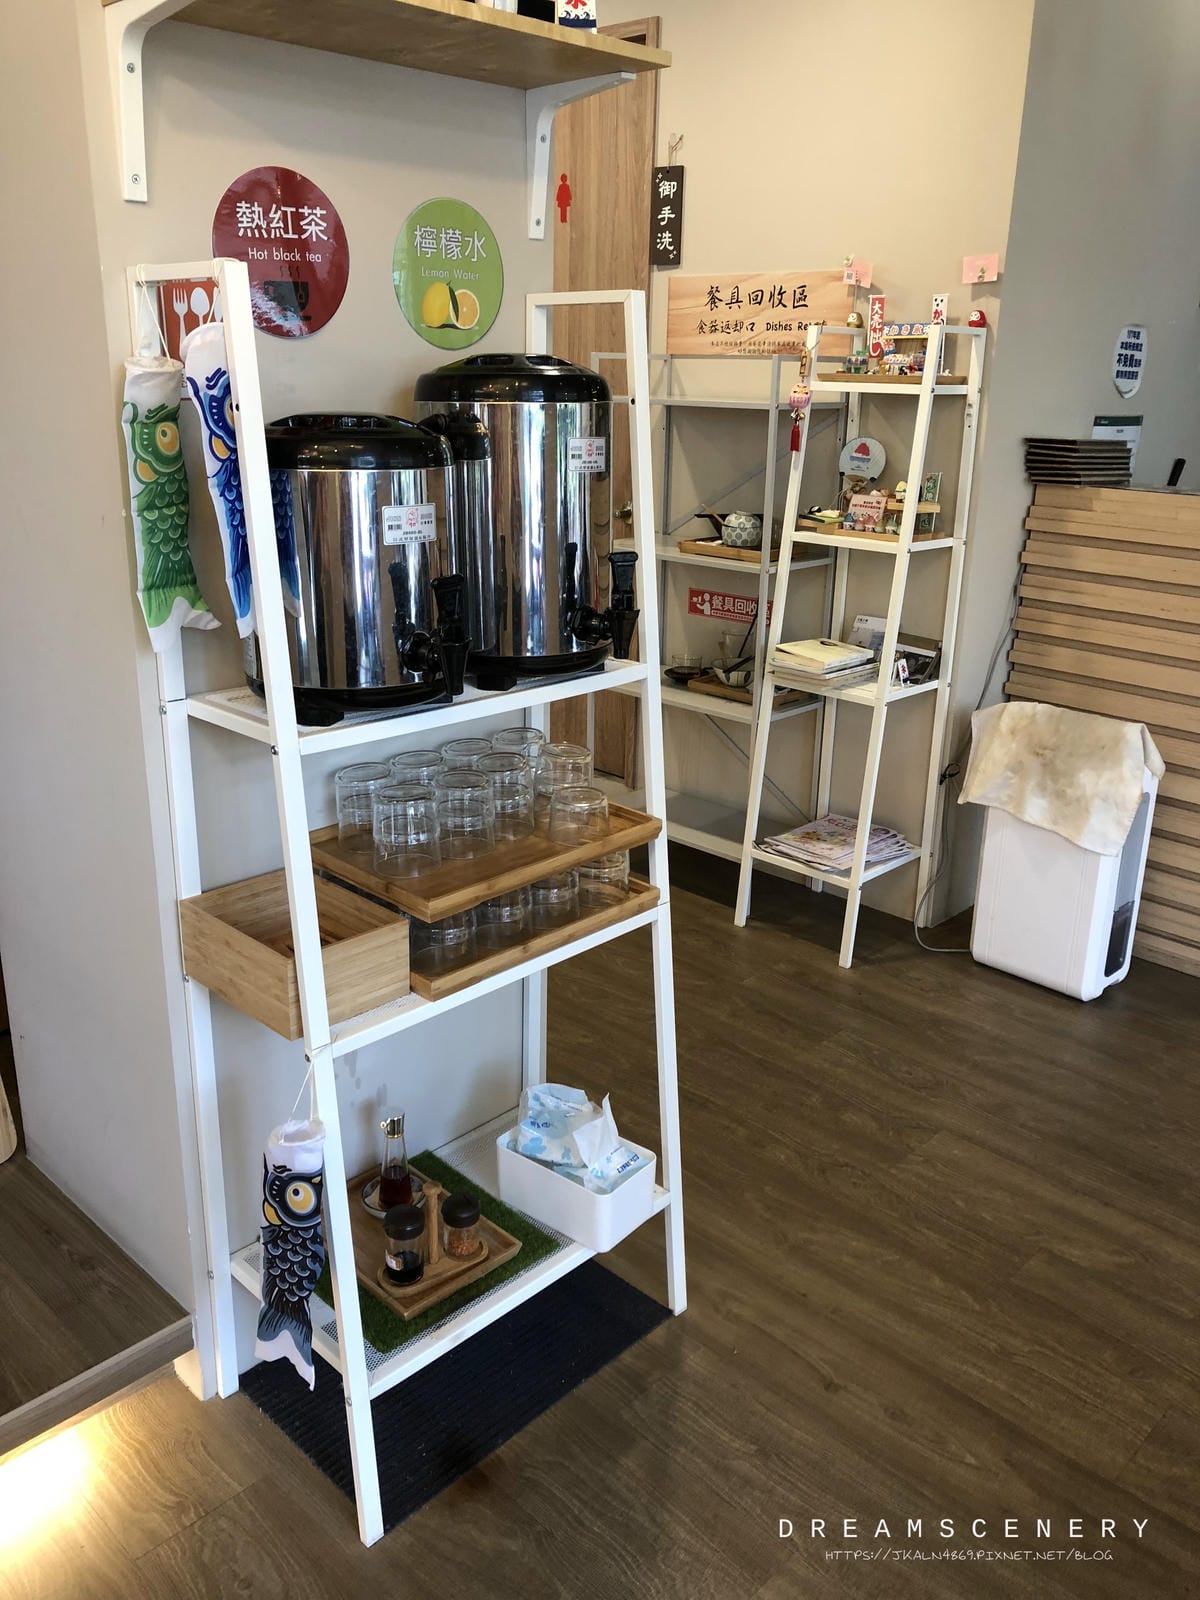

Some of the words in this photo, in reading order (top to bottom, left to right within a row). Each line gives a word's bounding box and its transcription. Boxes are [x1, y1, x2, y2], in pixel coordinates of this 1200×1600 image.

[236, 200, 328, 242] 熱紅茶
[656, 180, 678, 251] 御手洗
[248, 247, 268, 260] Hot
[273, 247, 301, 261] black
[306, 251, 322, 262] tea
[414, 224, 487, 262] 檸檬水
[421, 266, 450, 279] Lemon
[454, 268, 479, 281] Water
[704, 284, 809, 312] 餐具回收區
[766, 321, 793, 332] Dishes
[869, 300, 884, 357] 大売出し
